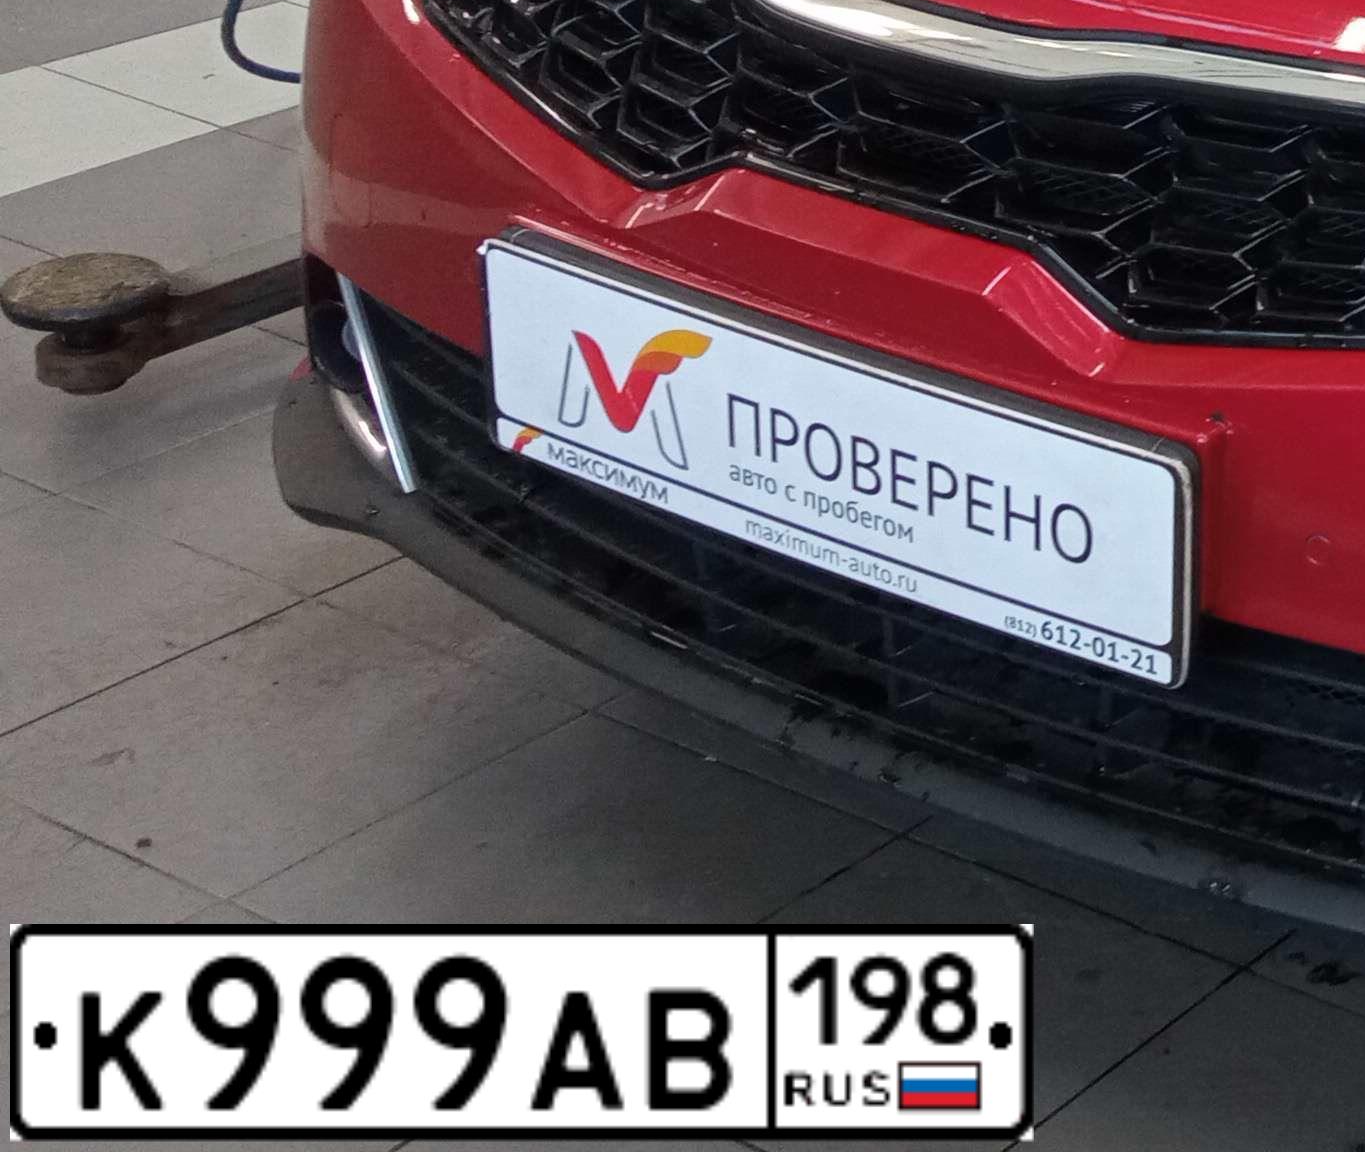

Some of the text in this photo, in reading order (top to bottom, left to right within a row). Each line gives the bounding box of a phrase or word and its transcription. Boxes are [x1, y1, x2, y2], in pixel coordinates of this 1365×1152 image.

[547, 442, 670, 505] максимум
[727, 393, 1093, 565] ПРОВЕРЕНО
[728, 464, 778, 495] авто
[803, 490, 915, 544] пробегом
[744, 518, 918, 594] maximum-auto.ru
[1041, 621, 1158, 675] 612-01-21
